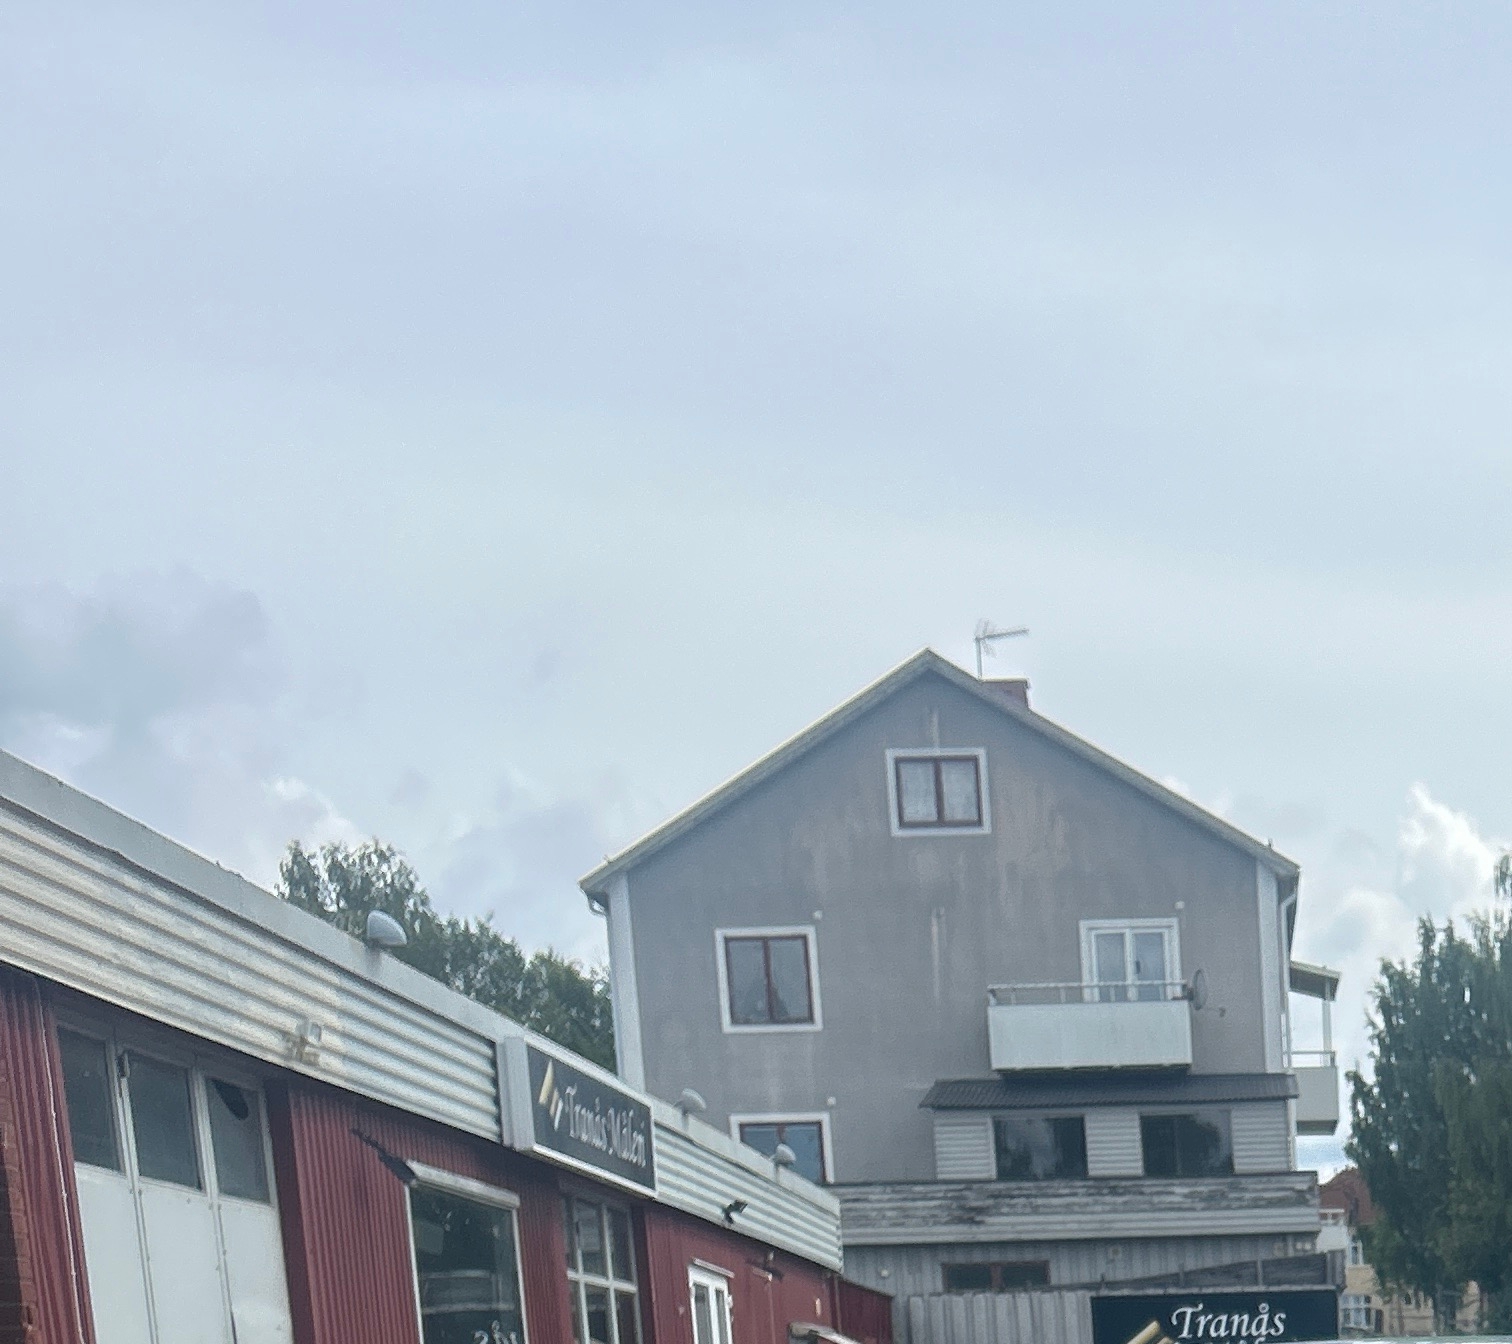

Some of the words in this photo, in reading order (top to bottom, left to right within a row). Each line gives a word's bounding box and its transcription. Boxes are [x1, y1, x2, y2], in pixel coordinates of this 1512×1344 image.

[564, 1083, 607, 1151] Tranås
[607, 1107, 646, 1167] Måleri
[1170, 1303, 1286, 1339] Tranås
